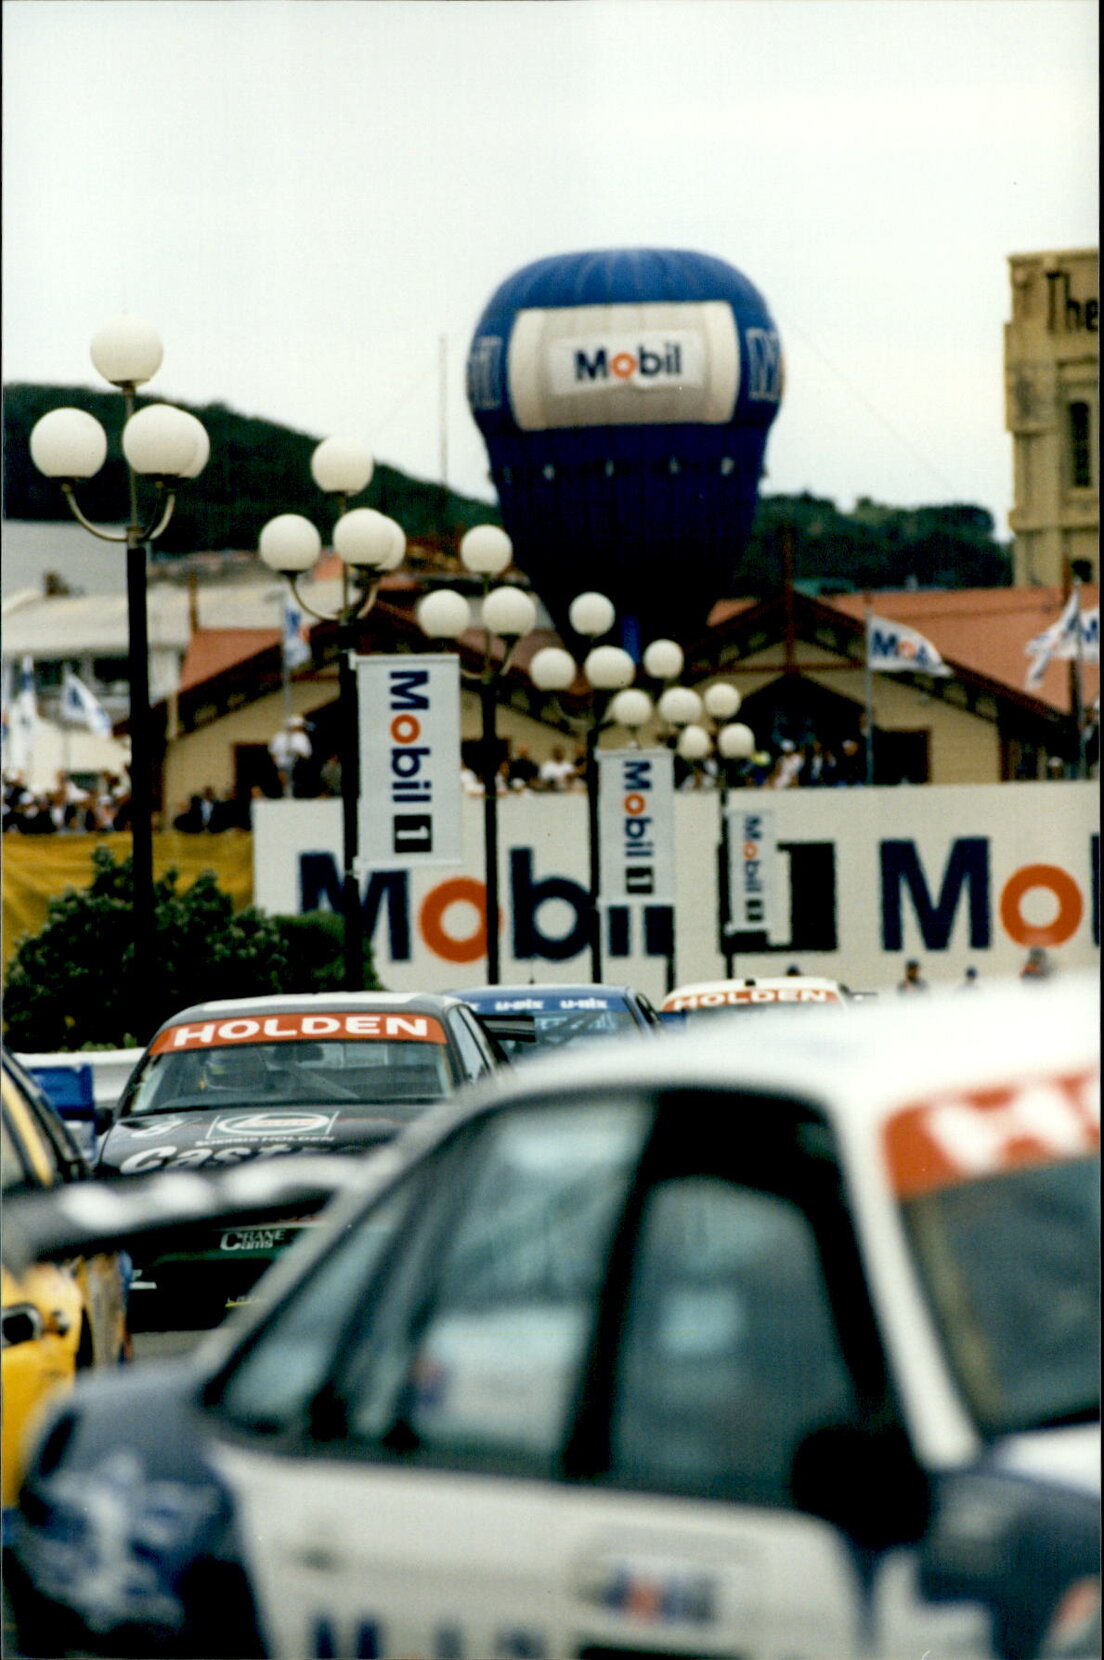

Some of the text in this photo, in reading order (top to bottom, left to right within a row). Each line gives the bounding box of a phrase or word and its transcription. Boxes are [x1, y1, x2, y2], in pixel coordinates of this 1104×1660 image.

[574, 343, 682, 381] Mobil
[388, 670, 431, 802] Mobil
[623, 760, 653, 858] Mobil
[673, 989, 827, 1011] HOLDEN
[173, 1016, 428, 1048] HOLDEN
